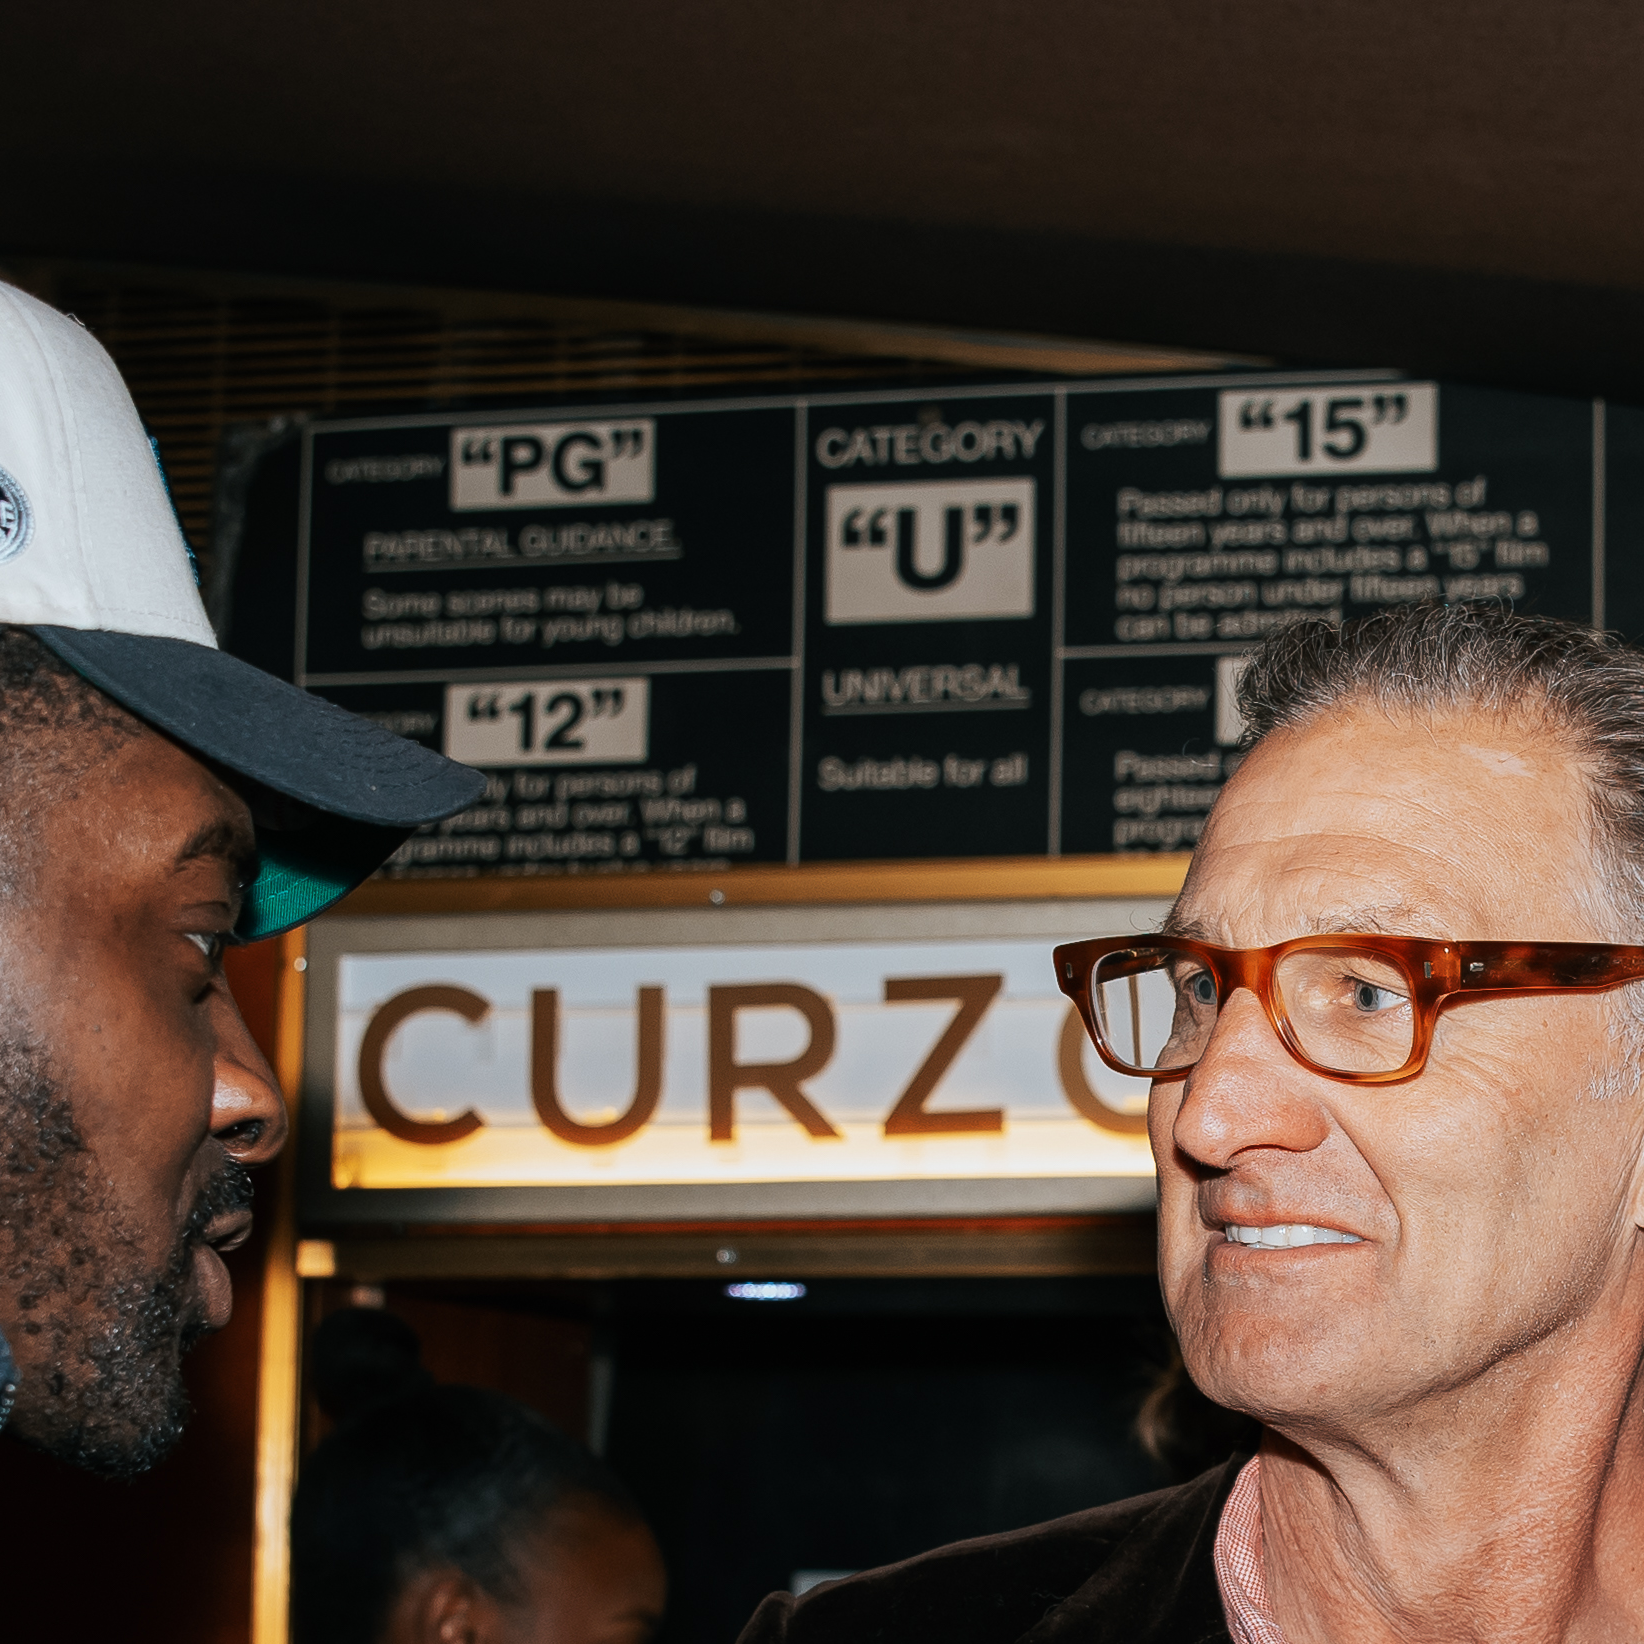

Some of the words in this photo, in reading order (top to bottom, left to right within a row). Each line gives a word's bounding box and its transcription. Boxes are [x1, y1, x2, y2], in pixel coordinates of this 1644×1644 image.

[816, 420, 1044, 468] CATEGORY
[1082, 420, 1211, 449] CATEGORY
[1238, 393, 1409, 461] “15”
[462, 429, 643, 496] “PG”
[1118, 487, 1223, 516] Passed
[1226, 485, 1286, 519] only
[1290, 482, 1329, 511] for
[1335, 483, 1451, 518] persons
[1455, 475, 1486, 507] of
[364, 528, 514, 561] PARENTAL
[841, 504, 1020, 589] “U”
[1117, 520, 1206, 547] fifteen
[1209, 518, 1287, 550] years
[1291, 513, 1348, 543] and
[1425, 510, 1513, 539] When
[1516, 511, 1539, 536] a
[1116, 551, 1279, 584] programme
[1283, 545, 1403, 574] includes
[1405, 546, 1428, 571] a
[1495, 541, 1550, 567] film
[363, 588, 442, 619] Some
[446, 588, 541, 617] scenes
[545, 586, 603, 616] may
[606, 582, 644, 609] be
[1116, 583, 1156, 609] no
[1158, 579, 1257, 613] person
[1261, 576, 1345, 606] under
[1350, 573, 1440, 602] fifteen
[363, 619, 497, 649] unsuitable
[501, 616, 536, 643] for
[540, 614, 624, 648] young
[1115, 614, 1171, 641] can
[1174, 611, 1214, 640] be
[822, 663, 1031, 703] UNIVERSAL
[1080, 686, 1211, 715] CATEGORY
[469, 689, 622, 750] “12”
[513, 771, 550, 798] for
[554, 770, 665, 802] persons
[666, 763, 698, 795] of
[819, 757, 940, 789] Suitable
[943, 753, 987, 786] for
[989, 753, 1028, 786] all
[1115, 750, 1221, 781] Passed
[515, 801, 569, 829] and
[639, 798, 722, 826] When
[724, 797, 747, 823] a
[504, 831, 616, 859] includes
[618, 830, 641, 856] a
[702, 826, 755, 852] film
